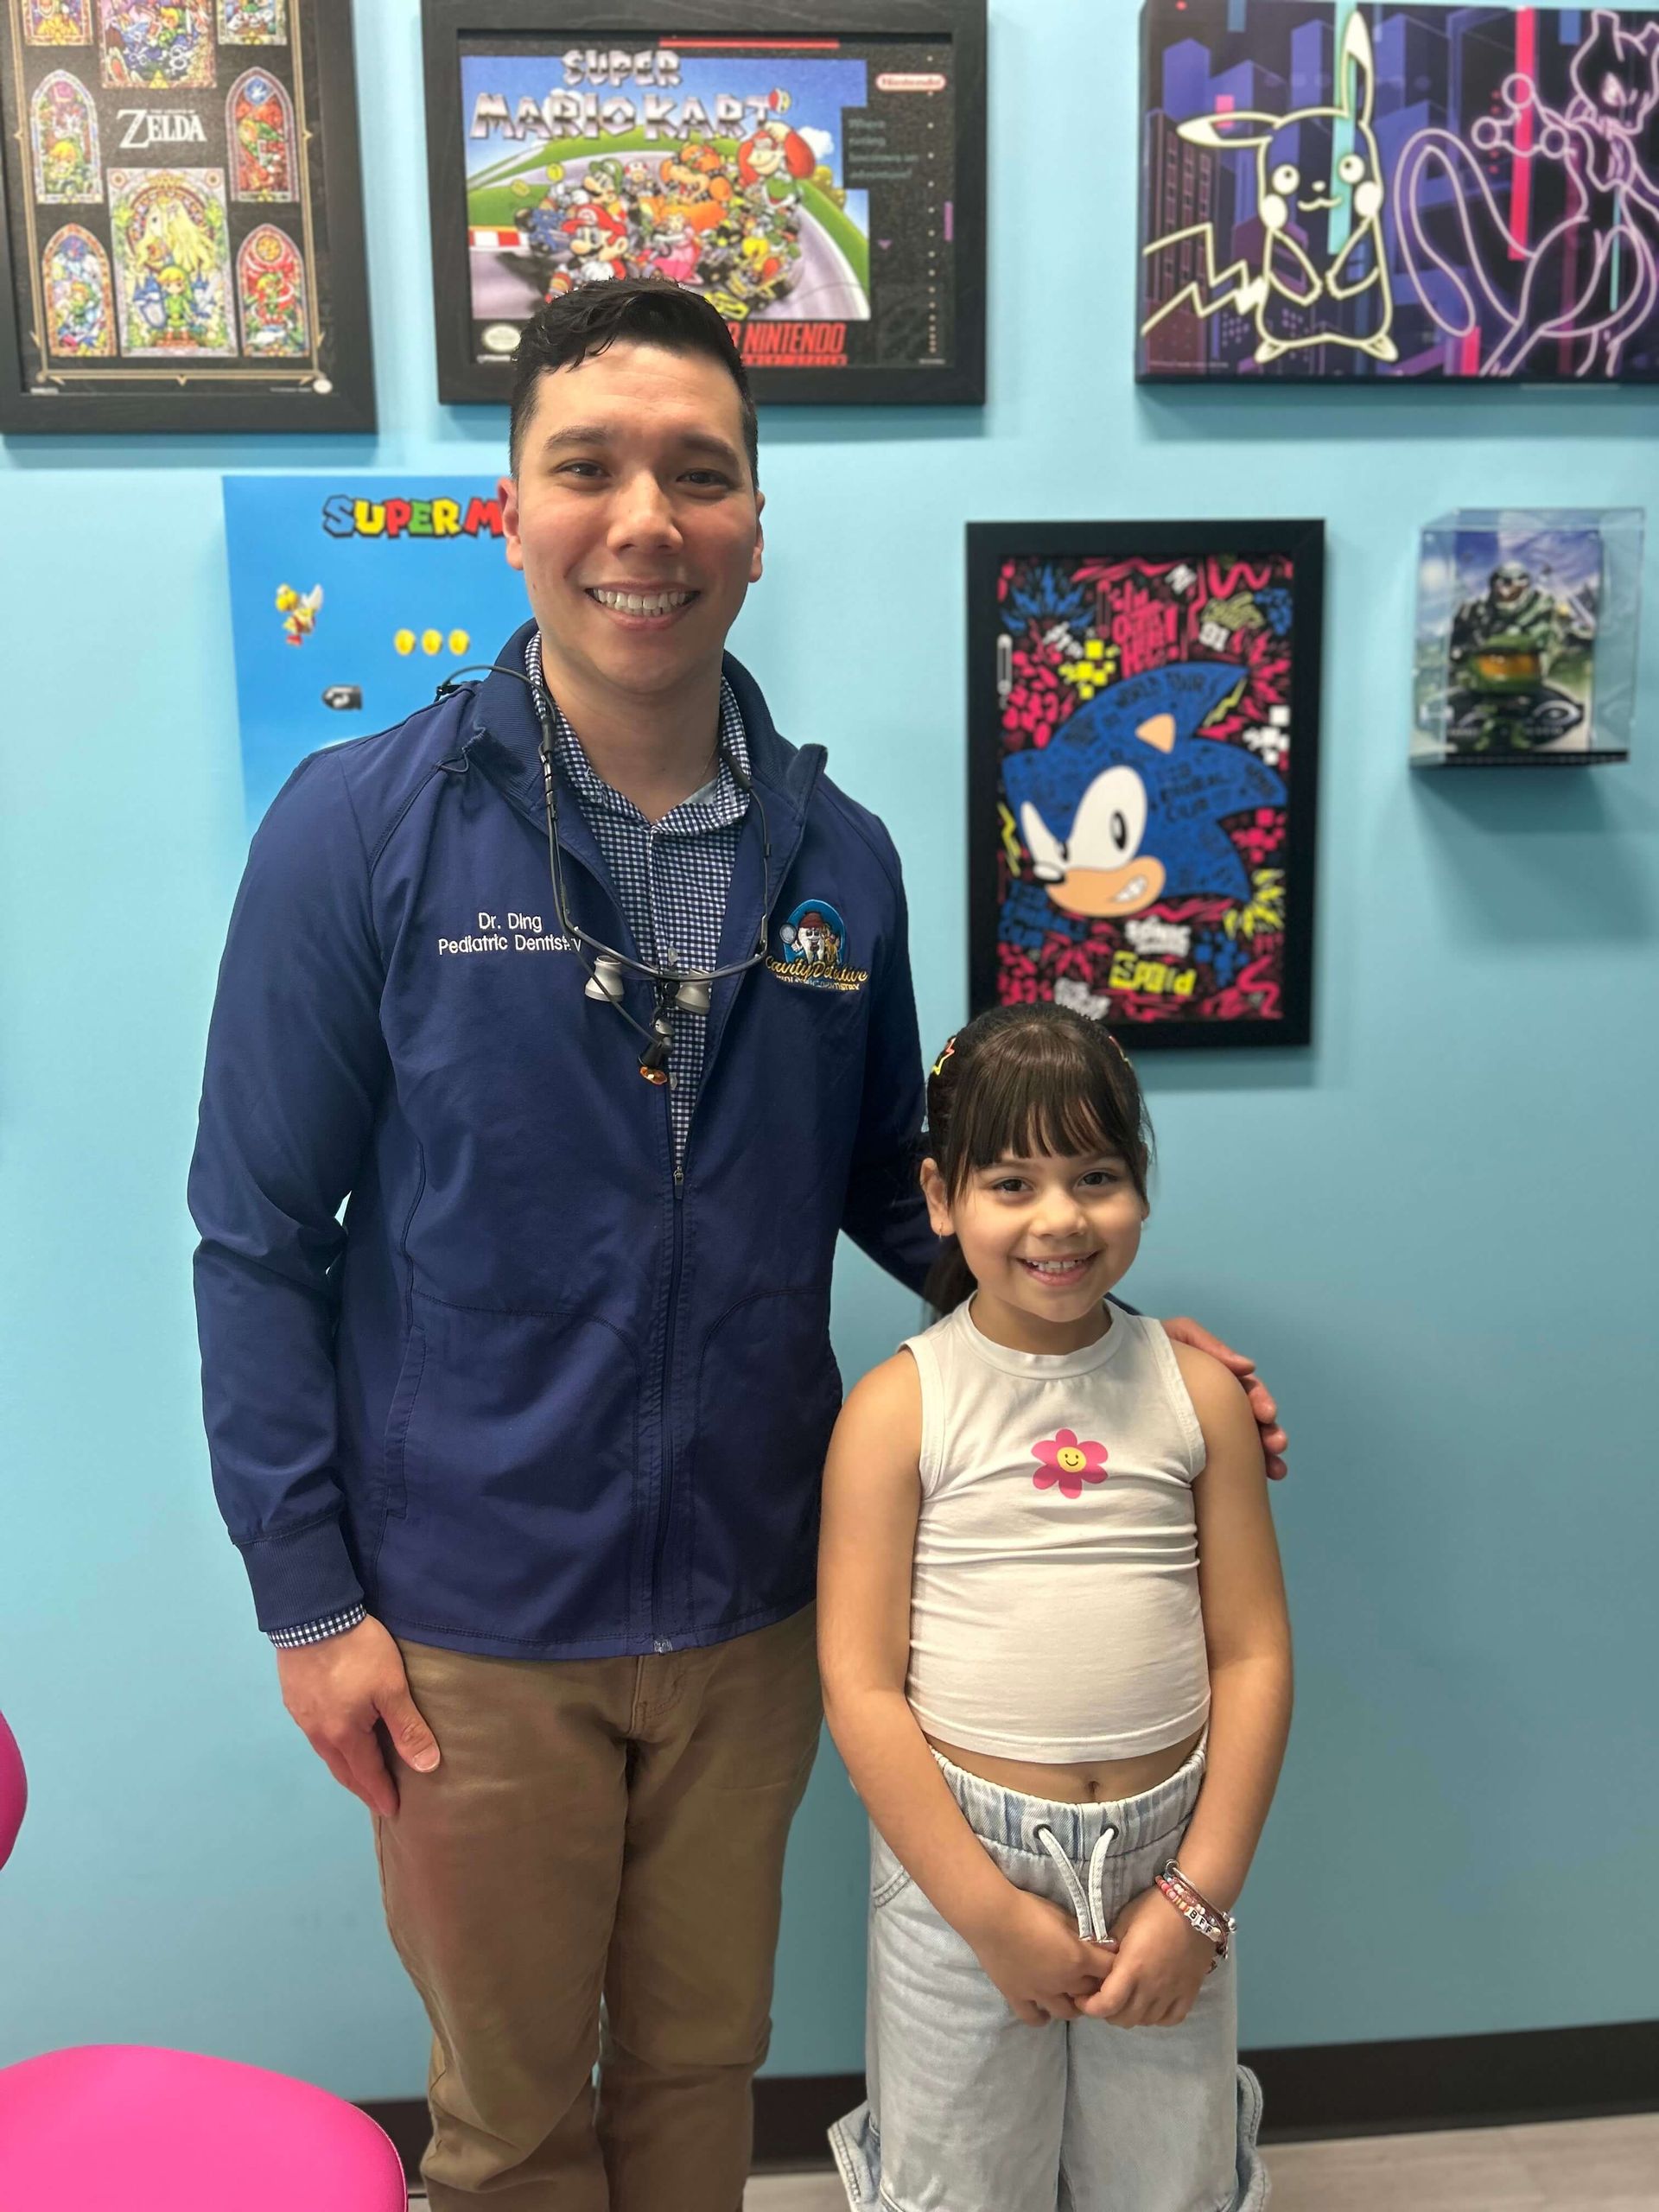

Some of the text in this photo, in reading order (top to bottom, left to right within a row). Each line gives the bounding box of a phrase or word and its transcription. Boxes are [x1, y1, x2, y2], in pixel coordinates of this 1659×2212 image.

[561, 49, 682, 86] SUPER
[115, 109, 207, 149] ZELDA
[469, 92, 771, 141] MARIO KART
[743, 322, 847, 353] NINTENDO
[322, 494, 462, 539] SUPER
[478, 912, 543, 933] Dr. Ding
[438, 933, 508, 956] Pediatric
[1189, 1909, 1212, 1933] BFF
